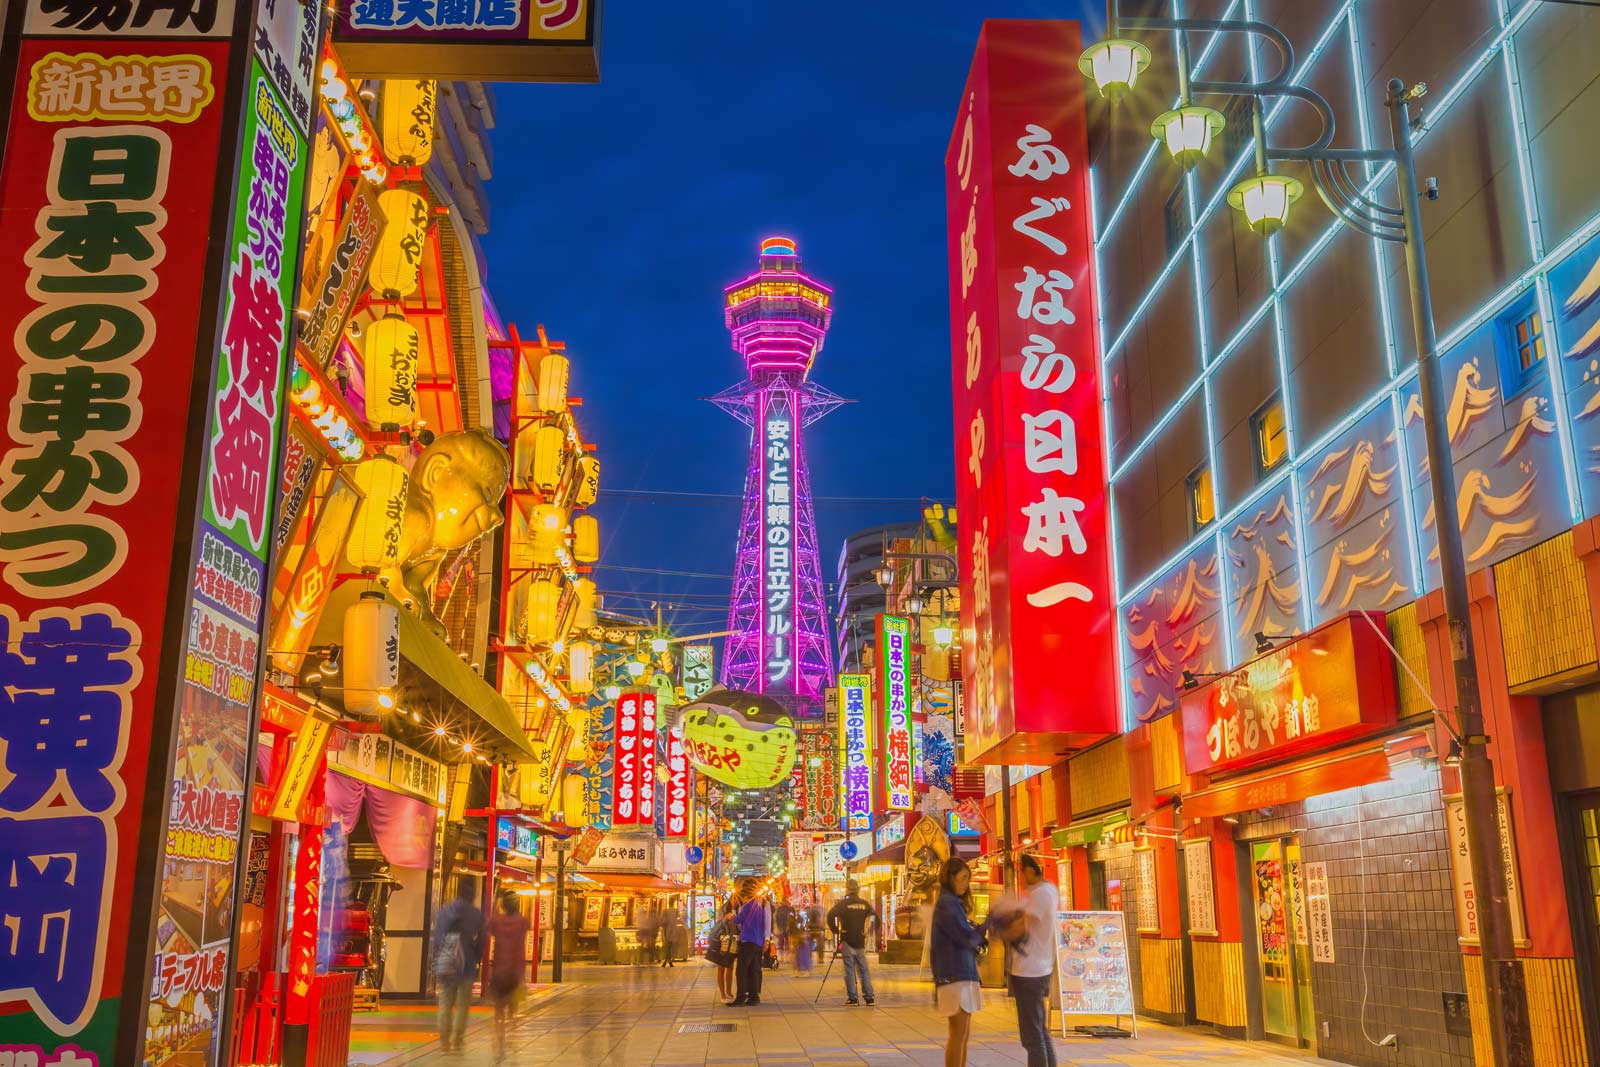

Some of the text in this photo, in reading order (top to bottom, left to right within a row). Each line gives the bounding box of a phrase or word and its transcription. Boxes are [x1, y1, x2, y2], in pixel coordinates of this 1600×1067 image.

[39, 62, 203, 114] 新世界
[257, 80, 297, 166] 新世界
[249, 129, 273, 257] 串かつ
[265, 157, 289, 280] 日本一の
[212, 252, 284, 542] 横綱
[1008, 123, 1093, 608] ふぐなら日本一
[202, 533, 259, 592] 新世界最大の
[766, 419, 792, 682] 安心と信頼の日立グループ
[199, 613, 257, 673] お座敷席
[890, 634, 905, 726] 日本一の串かつ
[846, 688, 865, 763] 日本一の串かつ
[888, 728, 910, 791] 横綱
[179, 782, 240, 831] 大小個室
[842, 763, 870, 814] 横綱
[892, 793, 910, 807] 酒処
[161, 950, 227, 994] テーブル席
